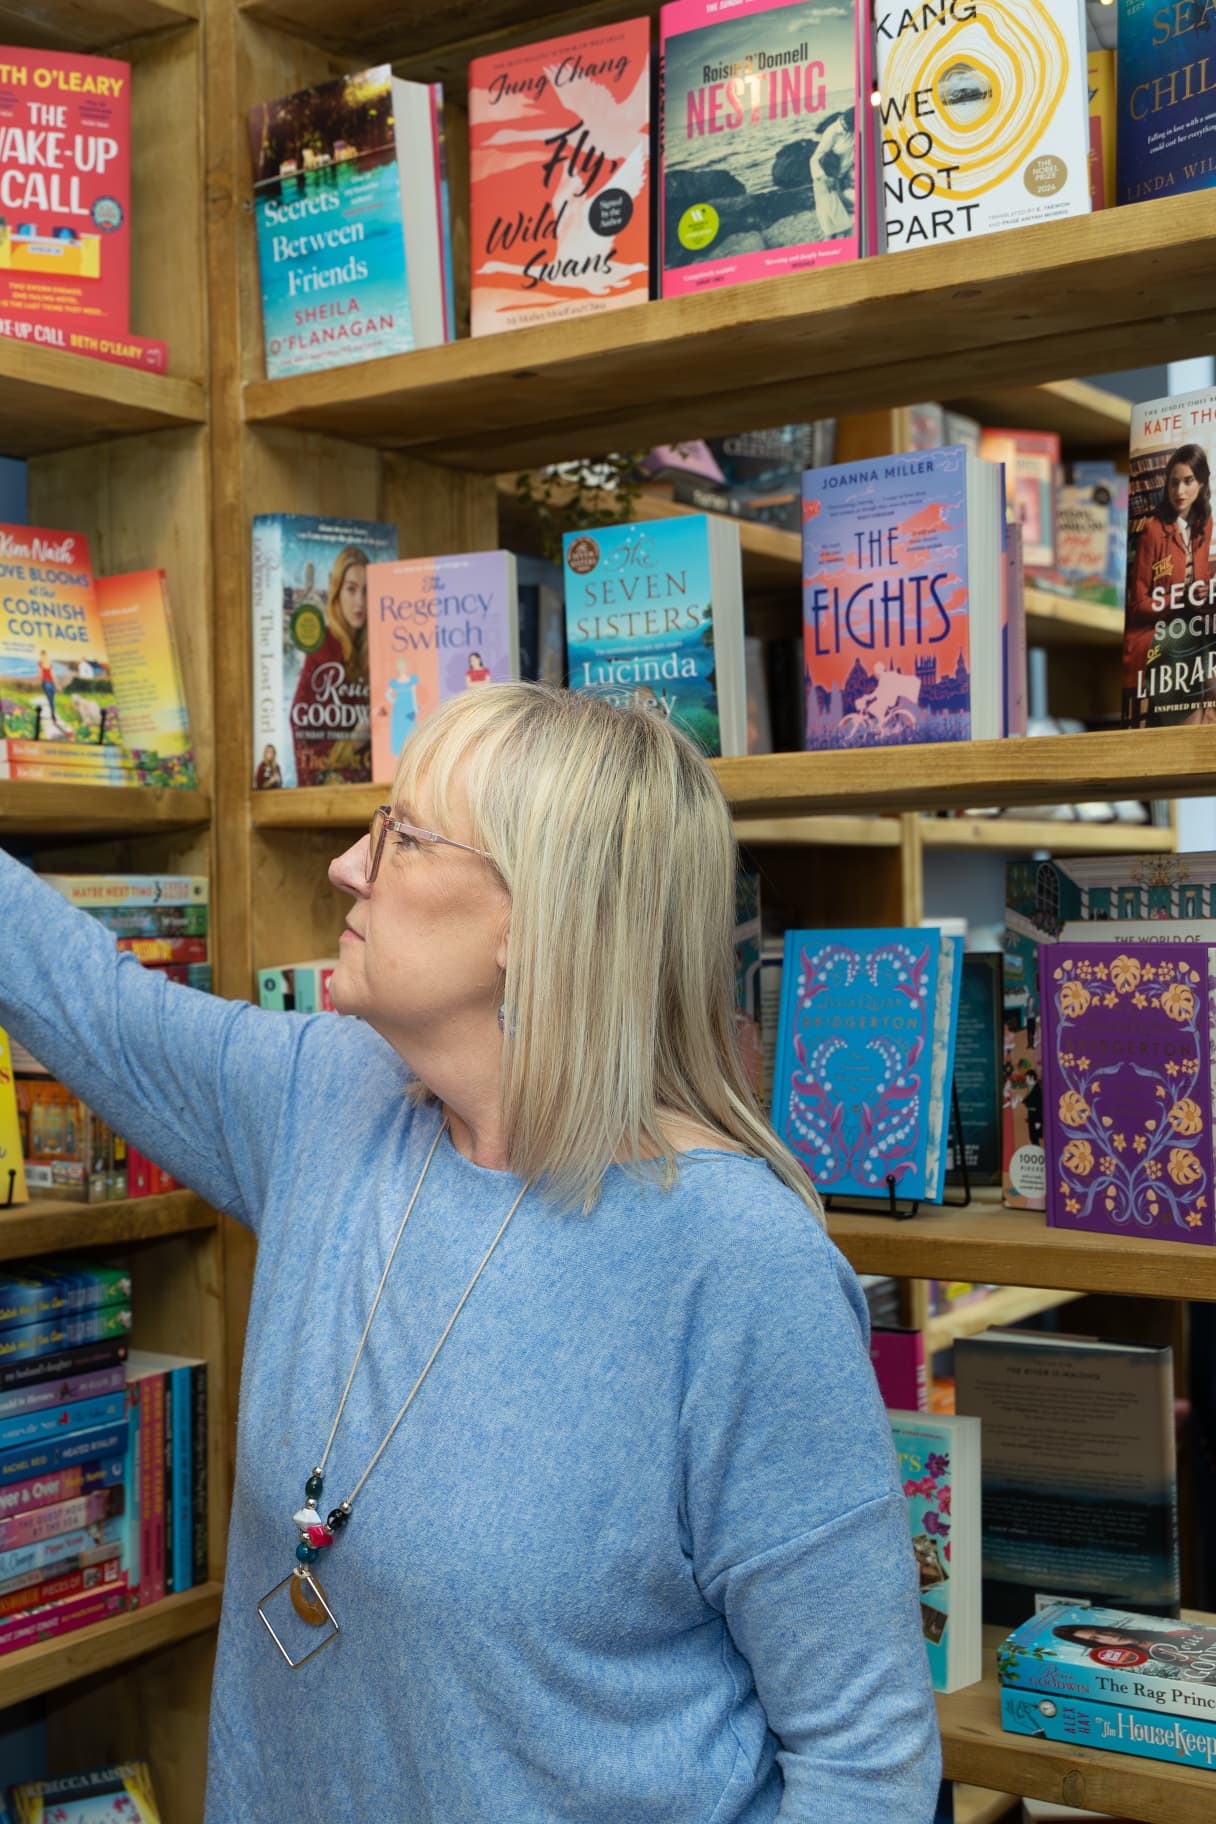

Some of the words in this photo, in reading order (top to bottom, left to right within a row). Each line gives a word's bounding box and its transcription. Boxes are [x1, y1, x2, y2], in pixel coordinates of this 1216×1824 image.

[33, 66, 124, 98] O'LEARY
[488, 72, 548, 105] Jung
[553, 52, 632, 88] Chang
[27, 102, 68, 129] THE
[685, 59, 826, 141] NESTING
[542, 119, 619, 198] Fly,
[0, 170, 89, 216] CALL
[263, 187, 340, 228] Secrets
[272, 220, 365, 263] Between
[485, 201, 568, 255] Wild
[884, 203, 981, 250] PART
[287, 255, 369, 296] Friends
[520, 249, 619, 290] Swans
[294, 298, 360, 325] SHEILA
[270, 313, 395, 355] O'FLANAGAN
[821, 468, 879, 489] JOANNA
[884, 461, 935, 480] MILLER
[854, 525, 900, 571] THE
[378, 589, 494, 623] Regency
[583, 569, 689, 608] SEVEN
[576, 602, 703, 645] SISTERS
[811, 572, 951, 656] EIGHTS
[390, 619, 484, 654] Switch
[582, 654, 697, 688] Lucinda
